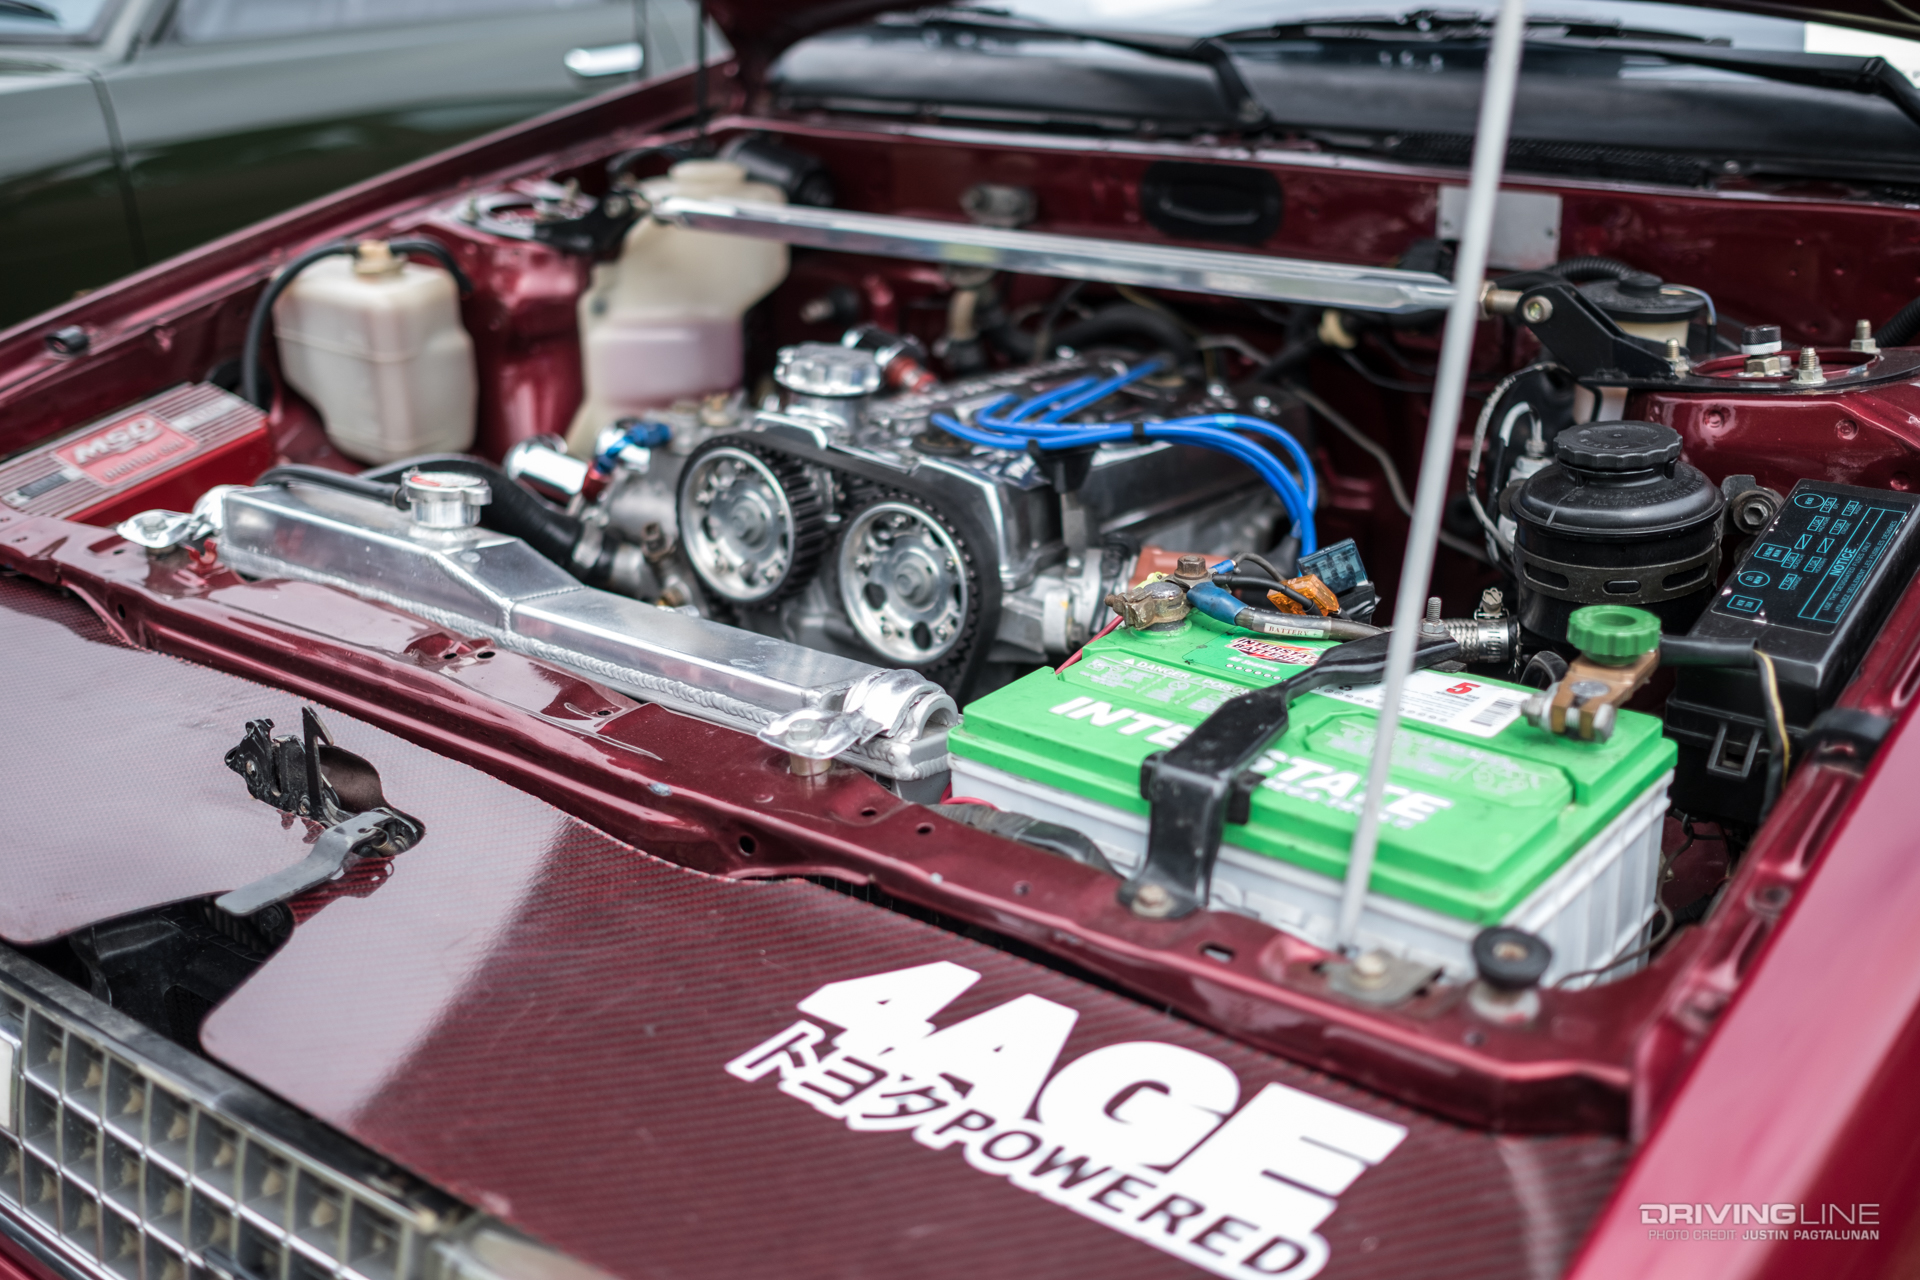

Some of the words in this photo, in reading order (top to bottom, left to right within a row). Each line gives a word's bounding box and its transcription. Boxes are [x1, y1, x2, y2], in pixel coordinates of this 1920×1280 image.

[74, 418, 157, 464] MSD
[1822, 602, 1833, 611] USE
[1829, 592, 1839, 601] THE
[1835, 566, 1856, 592] DESIGNATED
[1852, 553, 1865, 567] FUSES
[1861, 541, 1872, 552] ONLY
[1829, 547, 1856, 577] NOTICE
[1834, 594, 1850, 613] UTILISEZ
[1846, 568, 1865, 594] SEULEMENT
[1863, 560, 1872, 569] LES
[1869, 540, 1885, 560] FUSIBLES
[1881, 520, 1898, 540] DESIGNES
[1269, 626, 1309, 637] BATTERY
[1134, 660, 1192, 681] DANGER
[1445, 681, 1481, 695] 5
[797, 960, 1408, 1235] 4AGE
[932, 1107, 1309, 1277] POWERED
